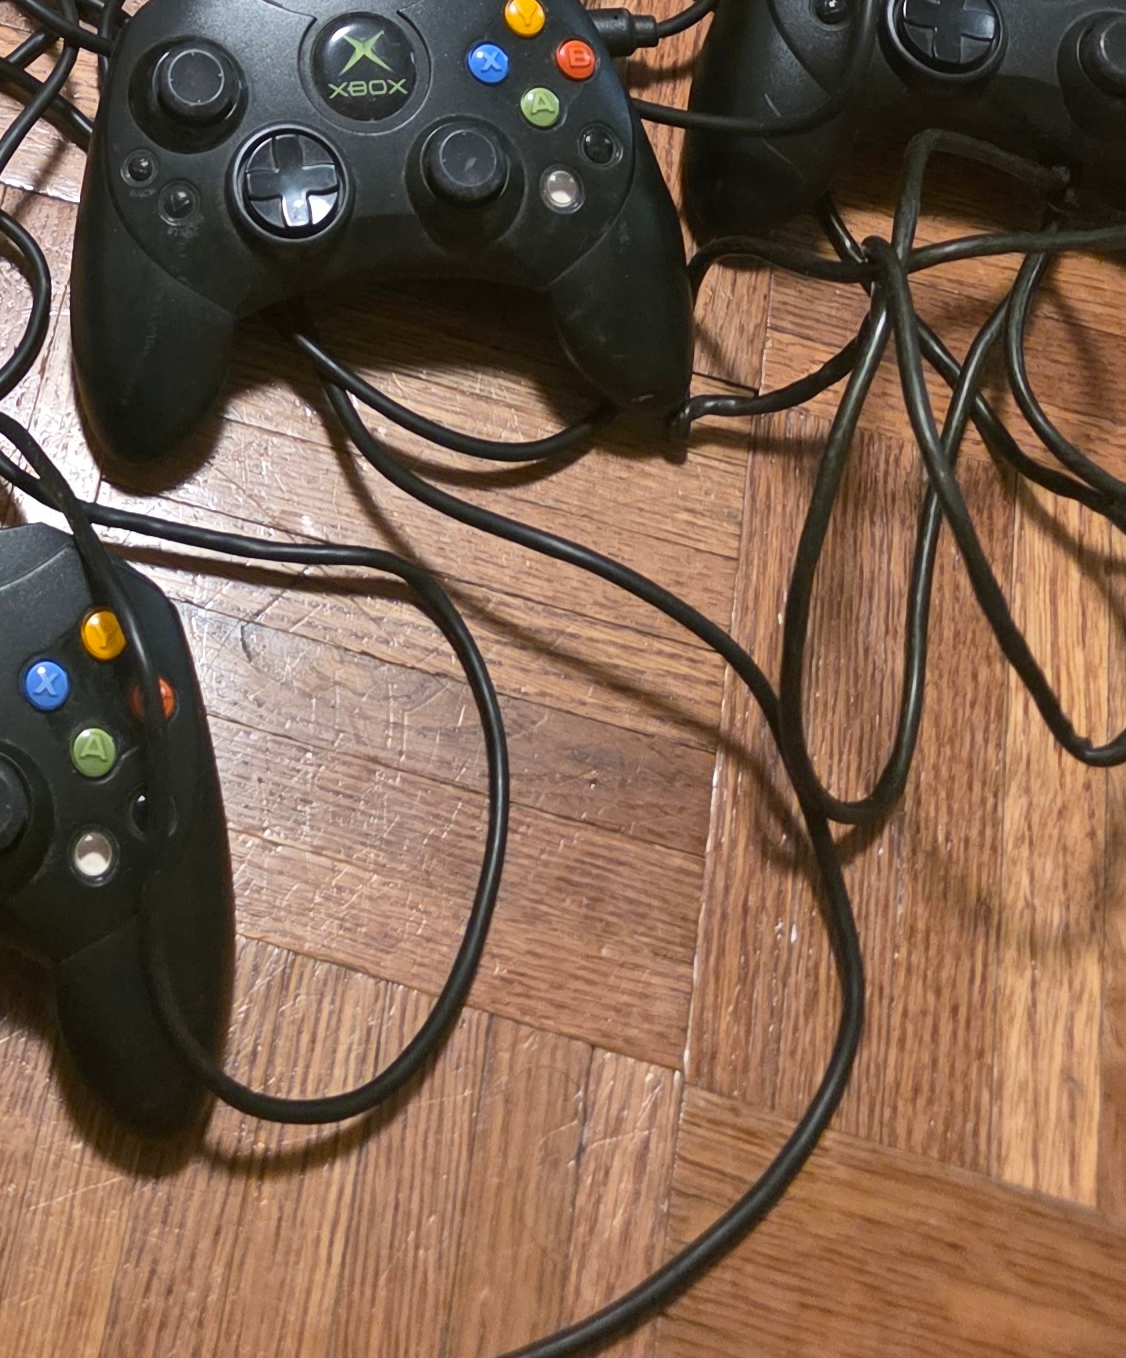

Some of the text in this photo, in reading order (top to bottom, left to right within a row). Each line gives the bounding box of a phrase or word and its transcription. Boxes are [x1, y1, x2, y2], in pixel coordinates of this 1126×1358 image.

[514, 4, 539, 28] Y
[480, 50, 504, 73] X
[567, 46, 592, 69] B
[327, 78, 409, 99] XBOX
[530, 92, 556, 116] A
[90, 625, 121, 650] Y
[32, 670, 61, 698] X
[79, 733, 109, 762] A
